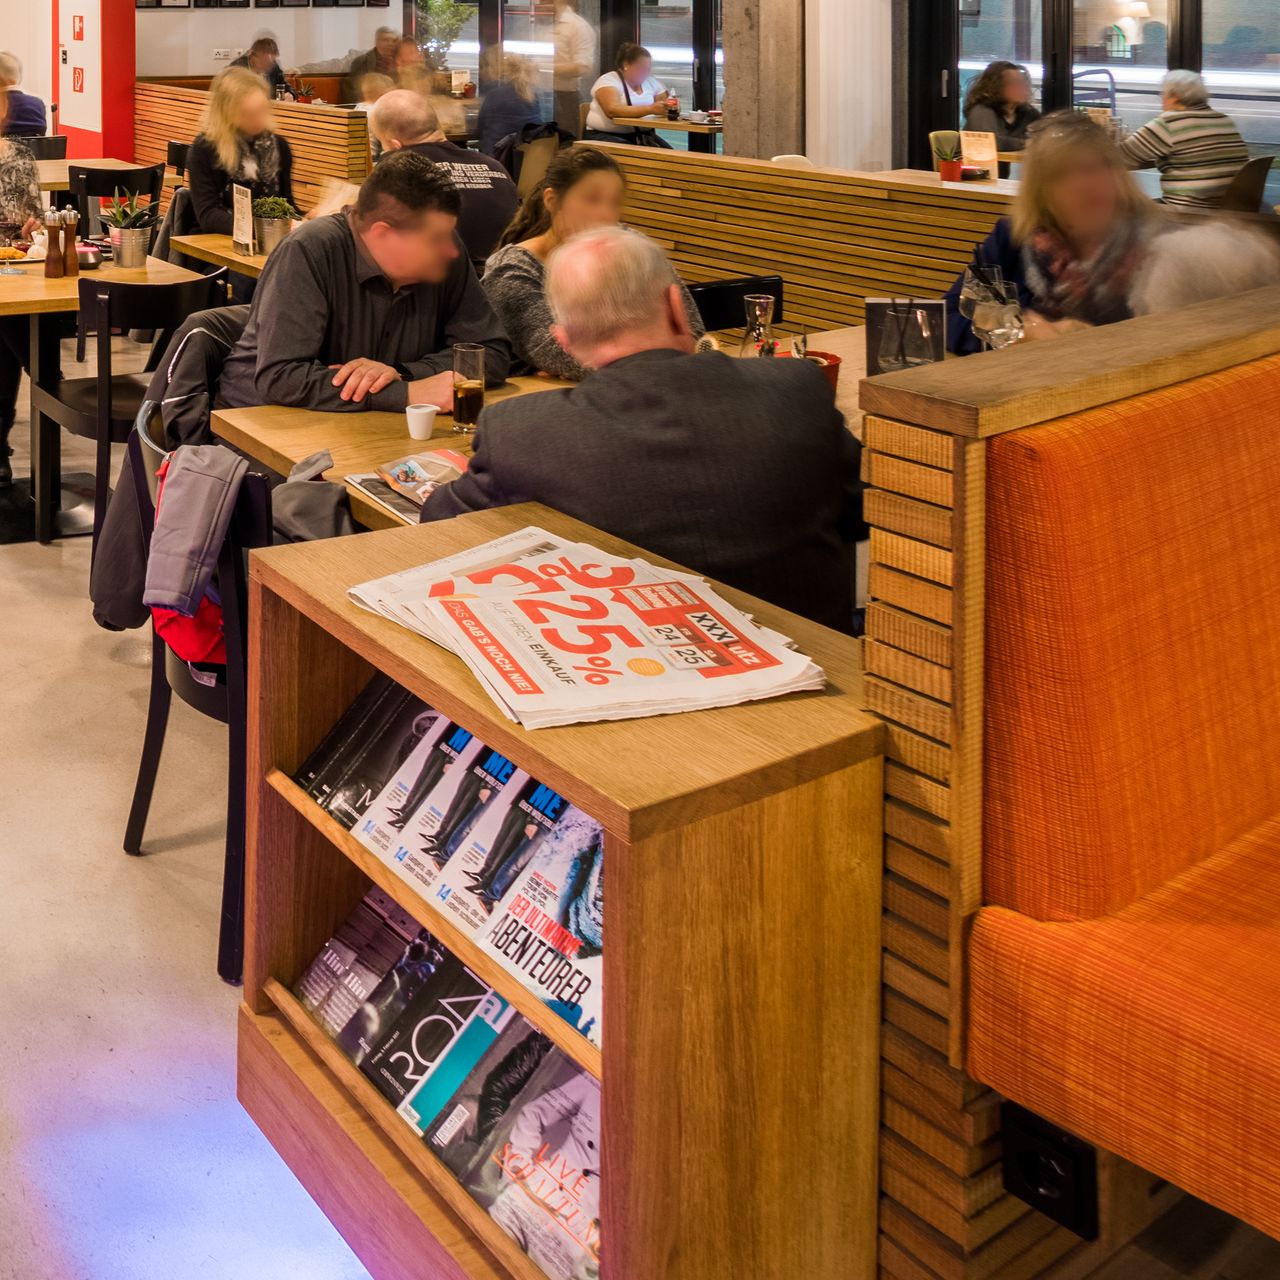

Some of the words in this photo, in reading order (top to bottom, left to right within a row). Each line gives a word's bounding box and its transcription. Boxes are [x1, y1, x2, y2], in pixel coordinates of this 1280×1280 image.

[452, 162, 490, 171] WEITER
[461, 618, 491, 644] GAB'S
[484, 644, 514, 671] NOCH
[506, 671, 534, 692] NIE!
[528, 643, 577, 687] EINKAUF
[654, 626, 680, 642] 24
[674, 648, 706, 665] 25
[394, 846, 409, 862] 14
[436, 883, 452, 902] 14
[507, 893, 527, 920] DER
[485, 913, 592, 1011] ABENTEURER
[535, 1142, 591, 1198] LIVE
